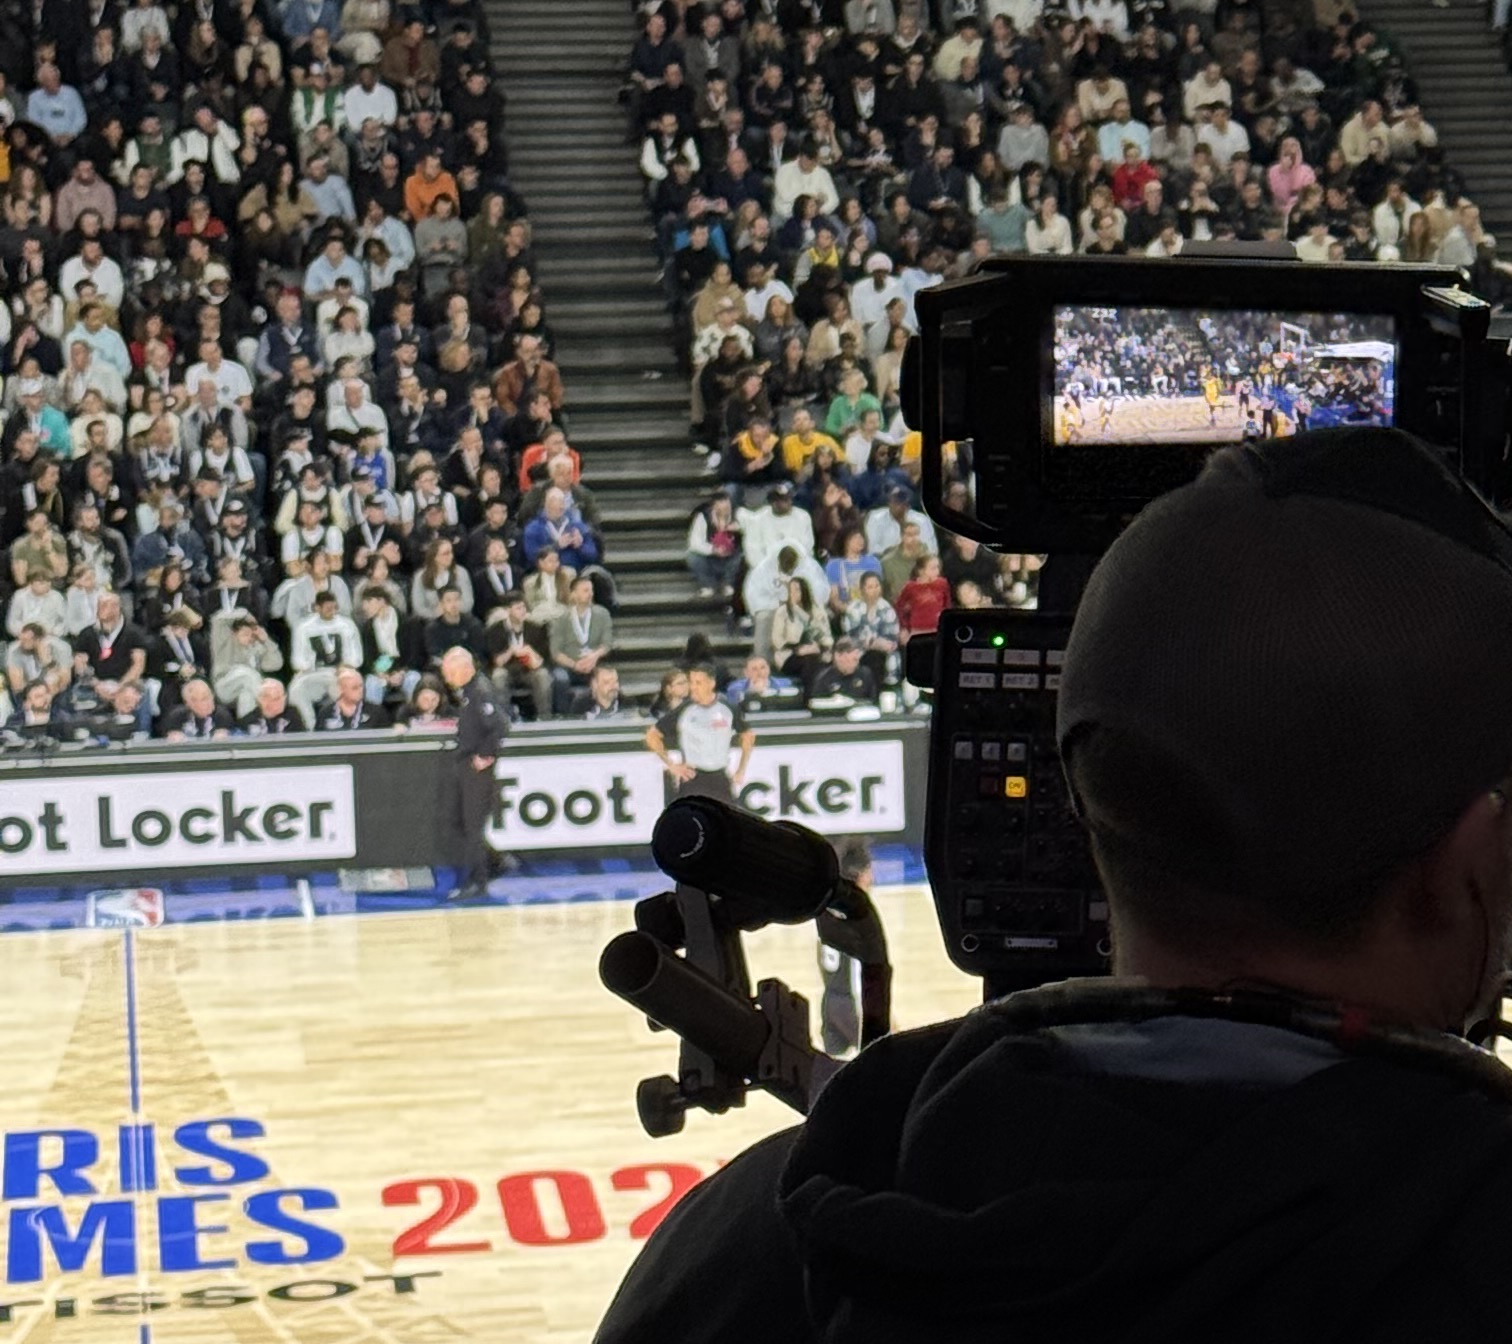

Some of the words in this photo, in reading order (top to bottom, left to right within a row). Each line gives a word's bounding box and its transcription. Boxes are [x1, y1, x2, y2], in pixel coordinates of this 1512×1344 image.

[0, 802, 68, 853] ot
[98, 790, 334, 848] Locker
[492, 776, 635, 829] Foot
[2, 1117, 270, 1200] RIS
[6, 1187, 347, 1284] MES
[381, 1159, 724, 1259] 202
